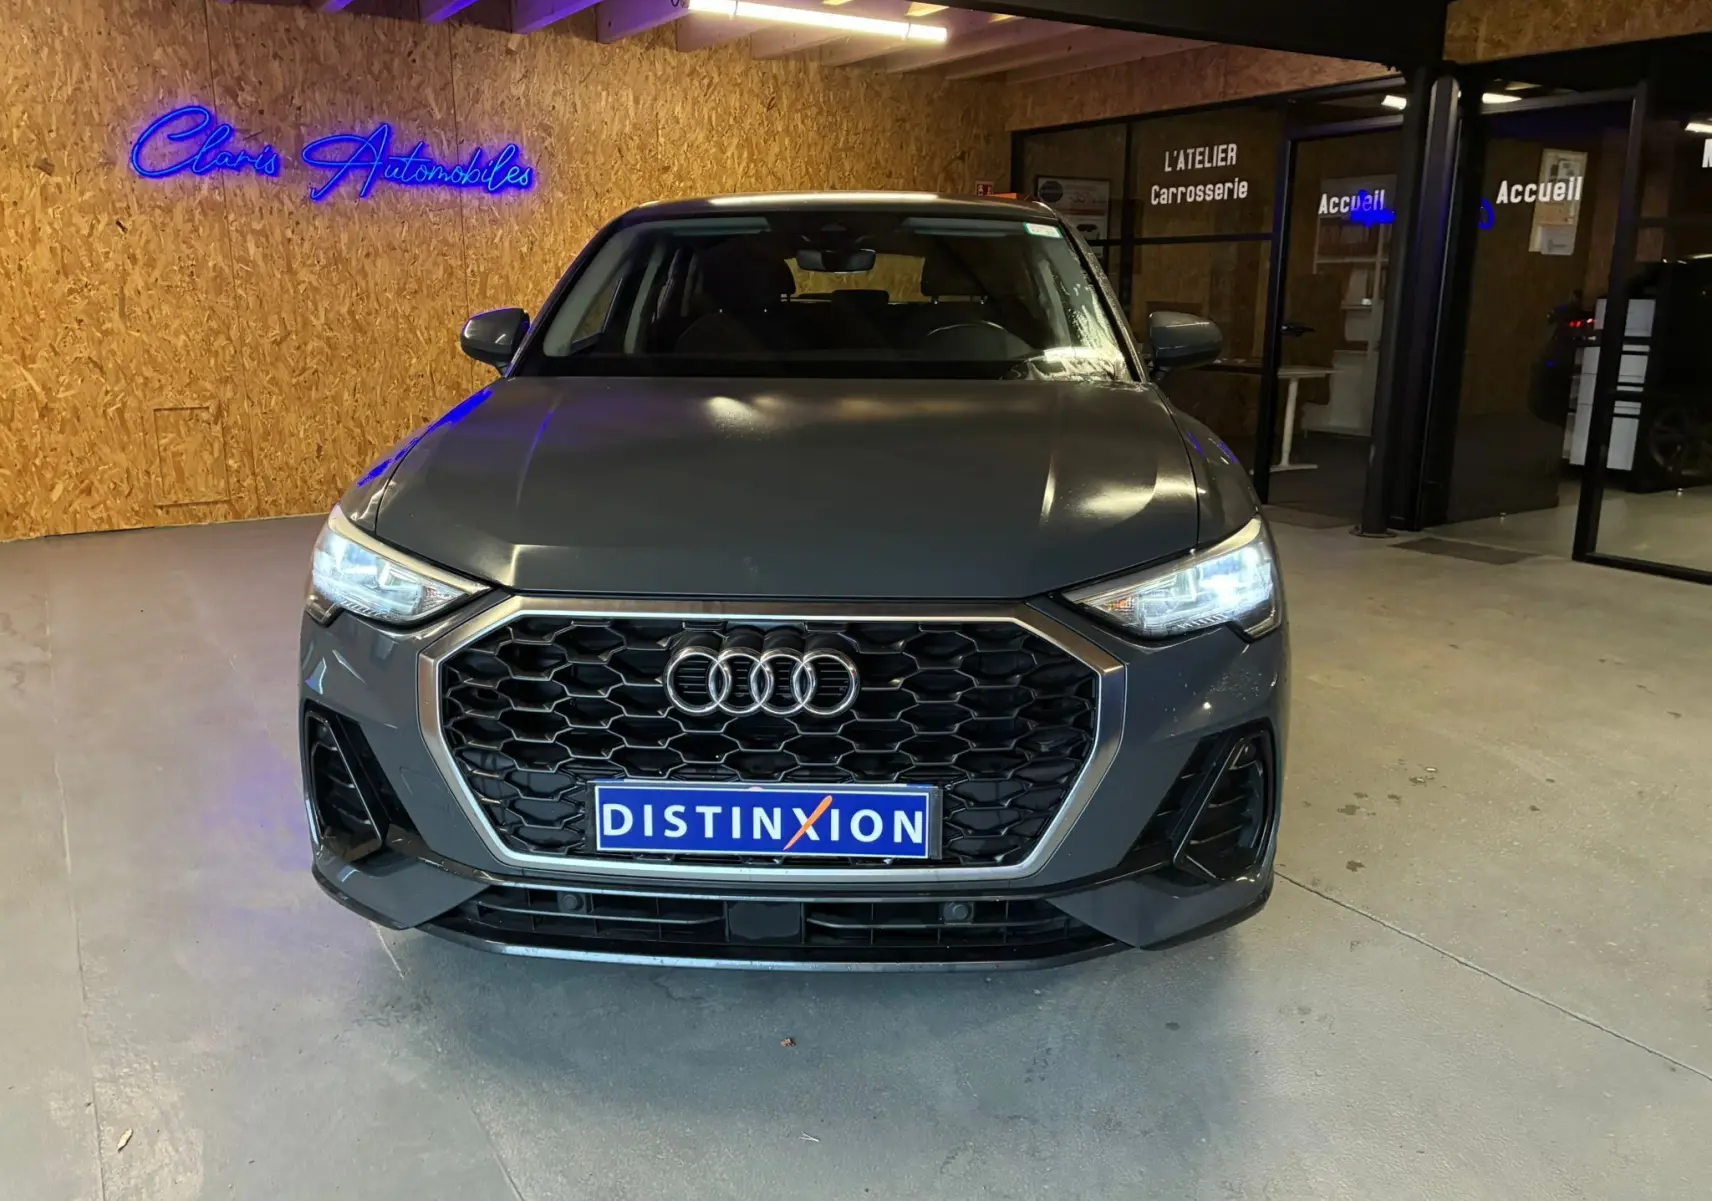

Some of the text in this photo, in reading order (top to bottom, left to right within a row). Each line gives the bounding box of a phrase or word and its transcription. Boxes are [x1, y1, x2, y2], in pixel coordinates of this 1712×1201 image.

[131, 105, 533, 199] Claris Automobiles
[1163, 143, 1238, 173] L'ATELIER
[1150, 177, 1249, 206] Carrosserie
[1318, 189, 1386, 215] Accueil
[1496, 176, 1583, 205] Accueil
[602, 795, 923, 851] DISTINXION
